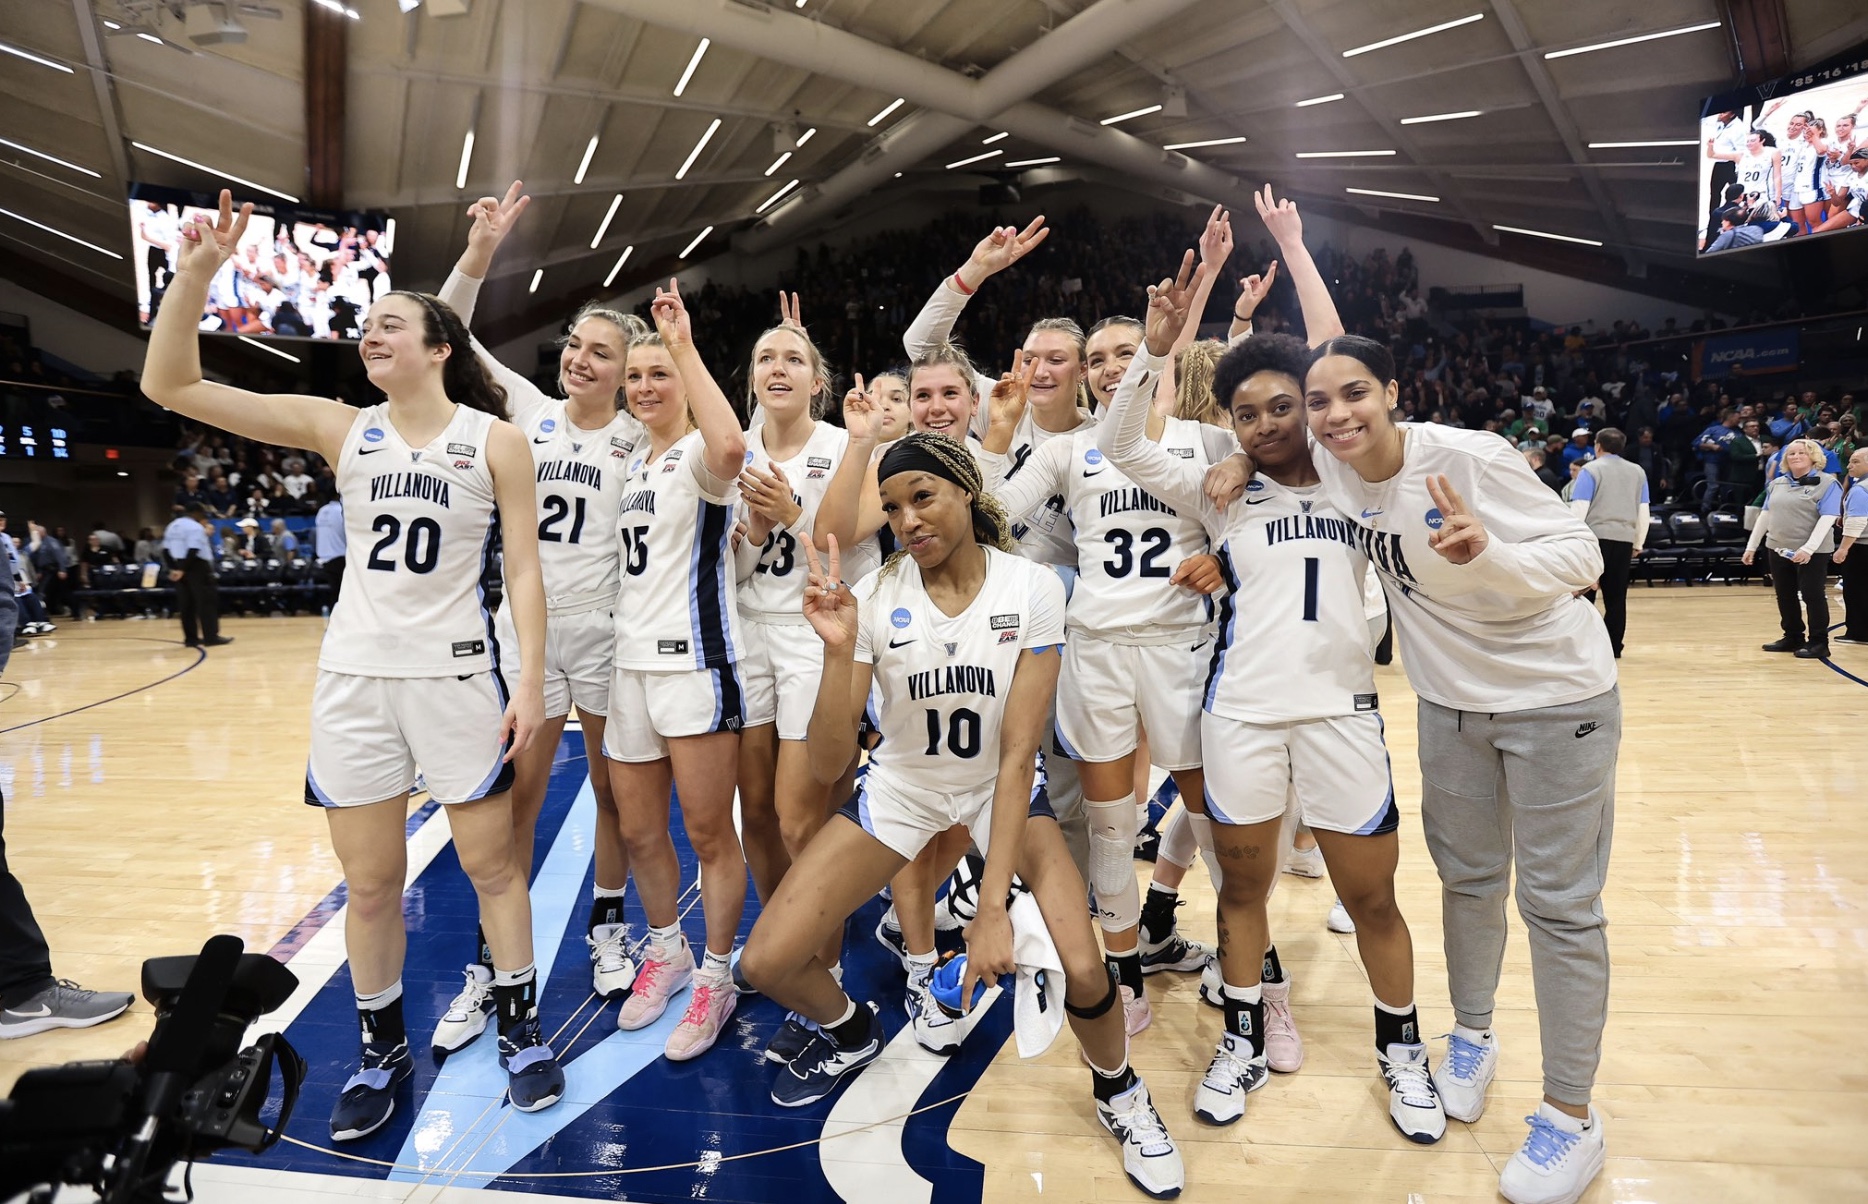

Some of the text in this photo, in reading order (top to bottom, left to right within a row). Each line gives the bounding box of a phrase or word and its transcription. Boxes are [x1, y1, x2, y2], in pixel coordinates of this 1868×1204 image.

[1790, 75, 1813, 87] '85
[1817, 67, 1842, 79] '16
[1744, 171, 1760, 182] 20
[1710, 347, 1790, 363] NCAA.com
[21, 425, 33, 437] 5
[370, 472, 450, 509] VILLANOVA
[536, 459, 601, 491] VILLANOVA
[538, 494, 586, 544] 21
[1265, 515, 1357, 551] VILLANOVA
[367, 513, 441, 574] 20
[620, 525, 650, 576] 15
[755, 529, 796, 577] 23
[1103, 527, 1172, 578] 32
[1302, 557, 1319, 622] 1
[907, 665, 996, 700] VILLANOVA
[924, 707, 981, 759] 10
[1579, 721, 1596, 732] NIKE
